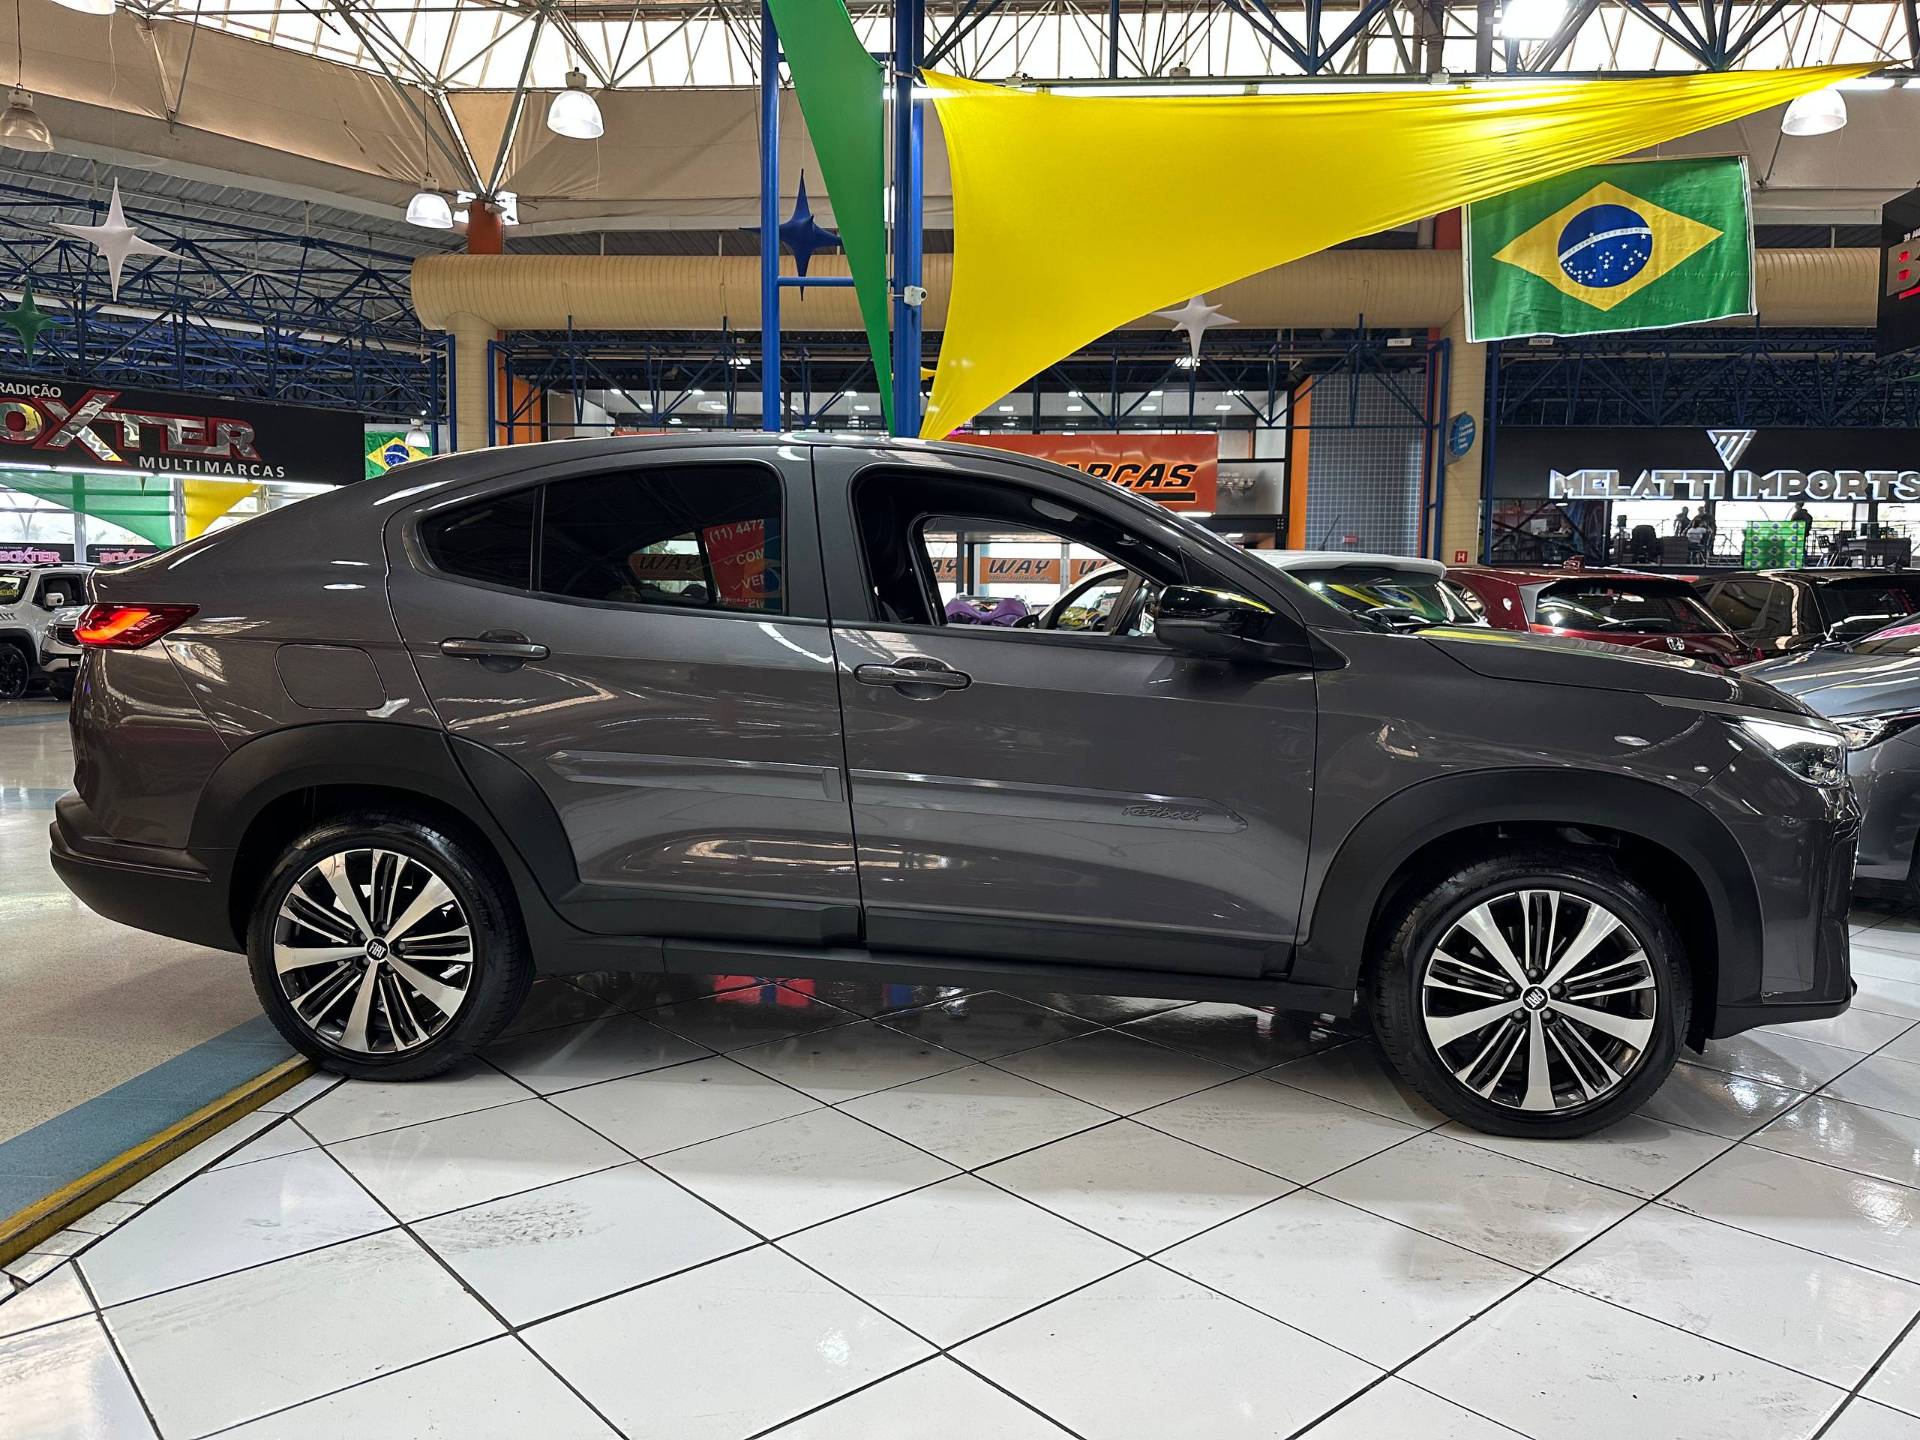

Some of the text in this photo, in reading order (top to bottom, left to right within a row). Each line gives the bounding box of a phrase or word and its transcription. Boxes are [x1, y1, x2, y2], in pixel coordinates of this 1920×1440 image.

[139, 455, 286, 478] MULTIMARCAS
[1549, 468, 1920, 500] MELATTI IMPORTS
[988, 559, 1050, 574] WAY
[1121, 804, 1203, 821] Fastback
[369, 942, 386, 958] FIAT
[1526, 989, 1545, 1008] FIAT
